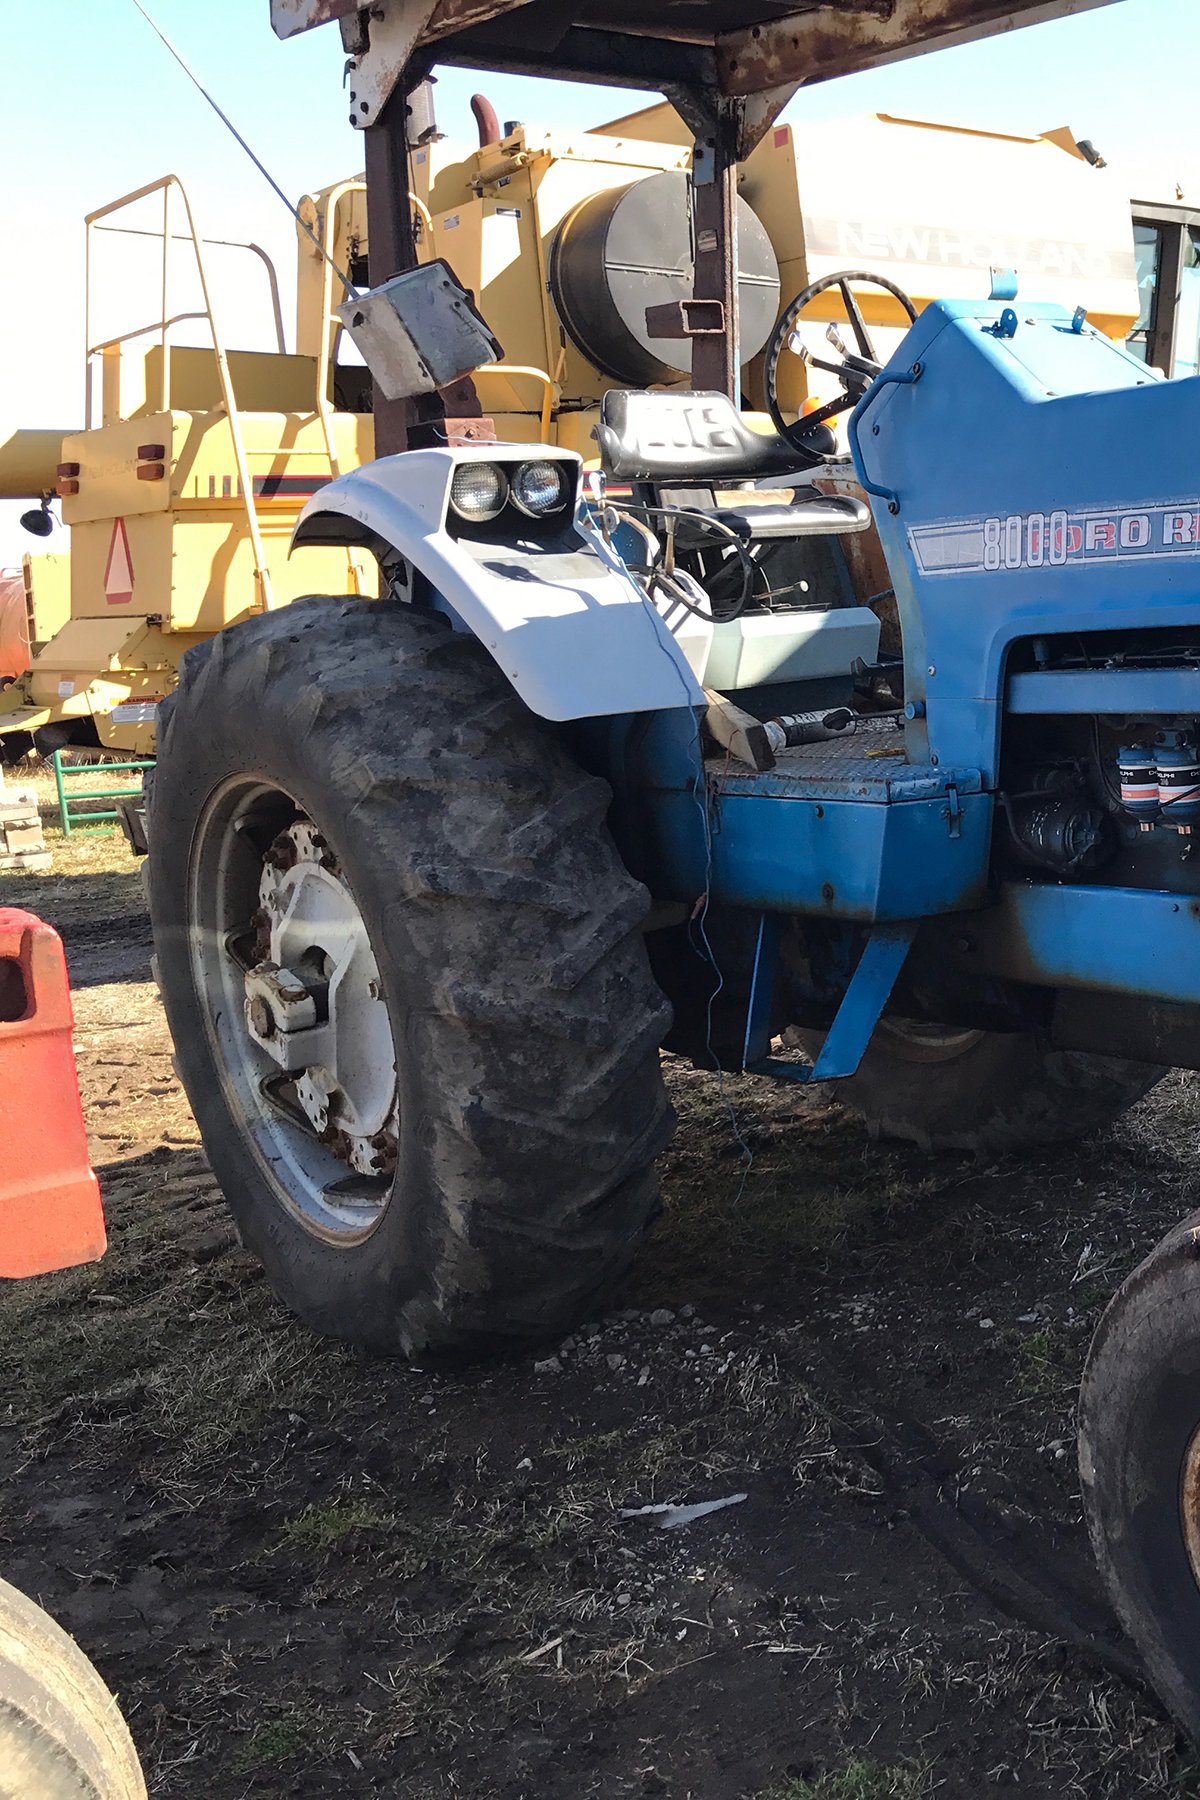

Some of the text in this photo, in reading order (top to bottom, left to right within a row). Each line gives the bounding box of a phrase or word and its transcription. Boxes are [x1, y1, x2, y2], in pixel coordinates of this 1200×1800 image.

[836, 220, 1112, 278] NEW HOLLAND
[983, 510, 1069, 571] 8000
